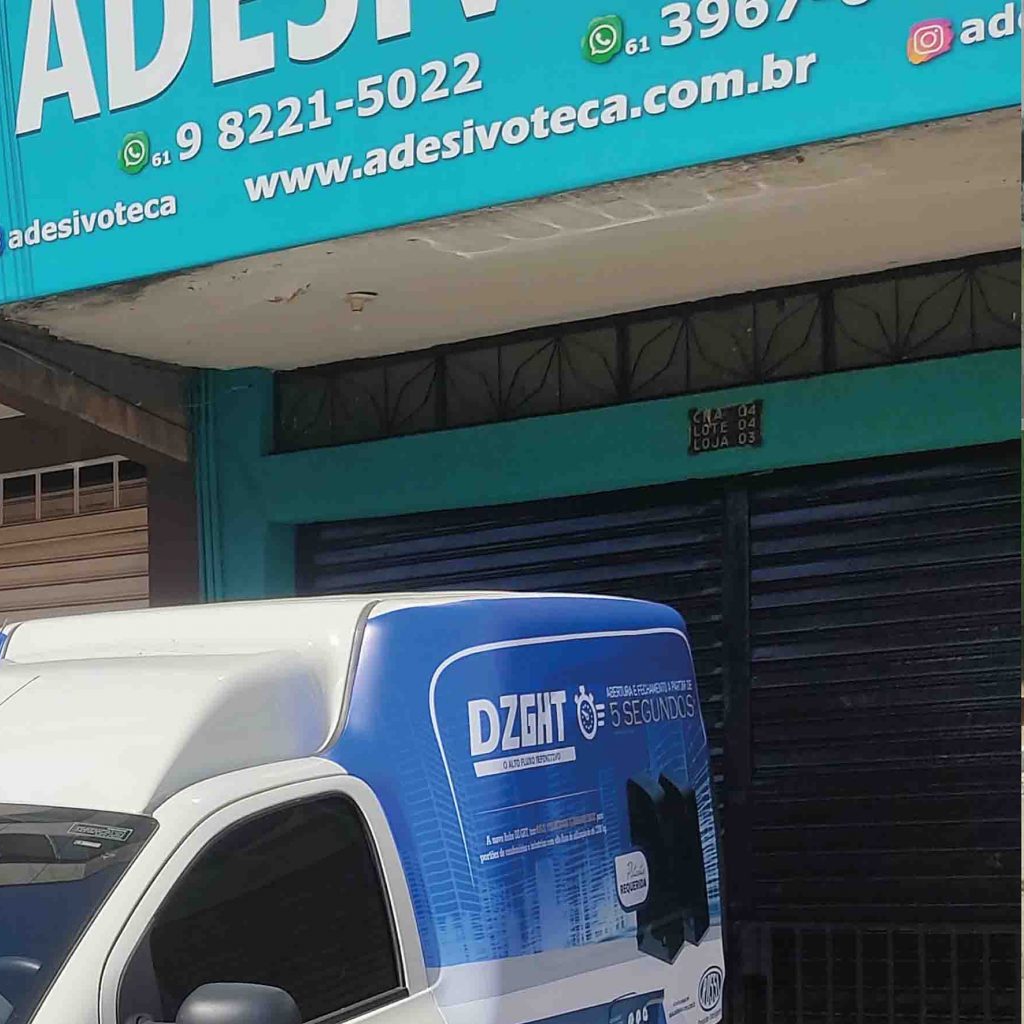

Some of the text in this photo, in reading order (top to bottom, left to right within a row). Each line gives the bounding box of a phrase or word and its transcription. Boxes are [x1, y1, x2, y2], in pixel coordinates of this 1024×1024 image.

[960, 2, 1022, 45] ad
[625, 36, 650, 55] 61
[151, 51, 484, 167] 61 9 8221-5022
[243, 52, 817, 202] www.adesivoteca.com.br
[7, 195, 177, 250] adesivoteca
[693, 420, 729, 437] LOTE
[693, 435, 729, 451] LOJA
[468, 690, 567, 757] DZGHT
[610, 694, 695, 727] 5 SEGUNDOS
